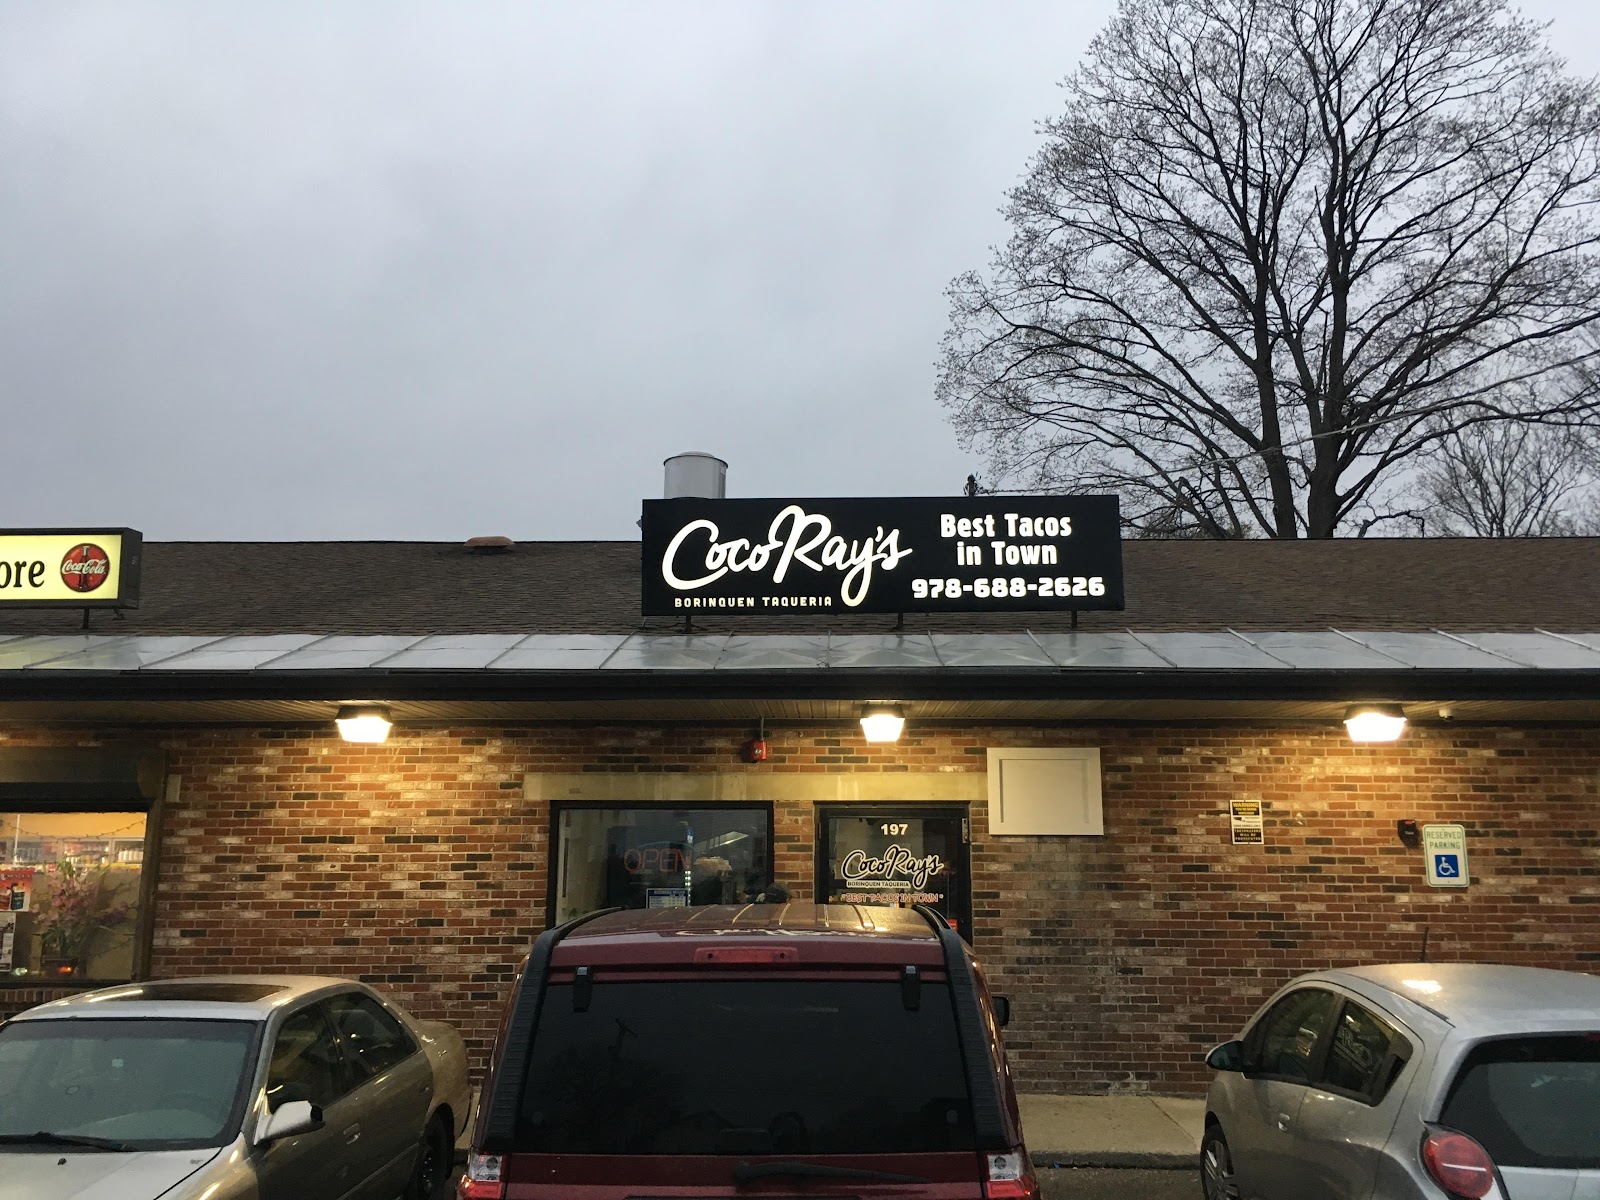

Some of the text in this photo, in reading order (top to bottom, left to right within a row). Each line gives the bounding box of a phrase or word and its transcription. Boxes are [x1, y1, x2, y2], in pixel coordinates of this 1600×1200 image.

[940, 513, 1072, 538] Best Tacos
[957, 541, 1058, 566] in Town
[912, 577, 1105, 598] 978-688-2626
[674, 596, 832, 608] BORINQUEN TAQUERIA
[881, 824, 908, 835] 197
[1426, 831, 1462, 840] RESERVED
[1429, 841, 1461, 850] PARKING
[624, 848, 692, 873] OPEN
[847, 880, 880, 888] BORINQUEN
